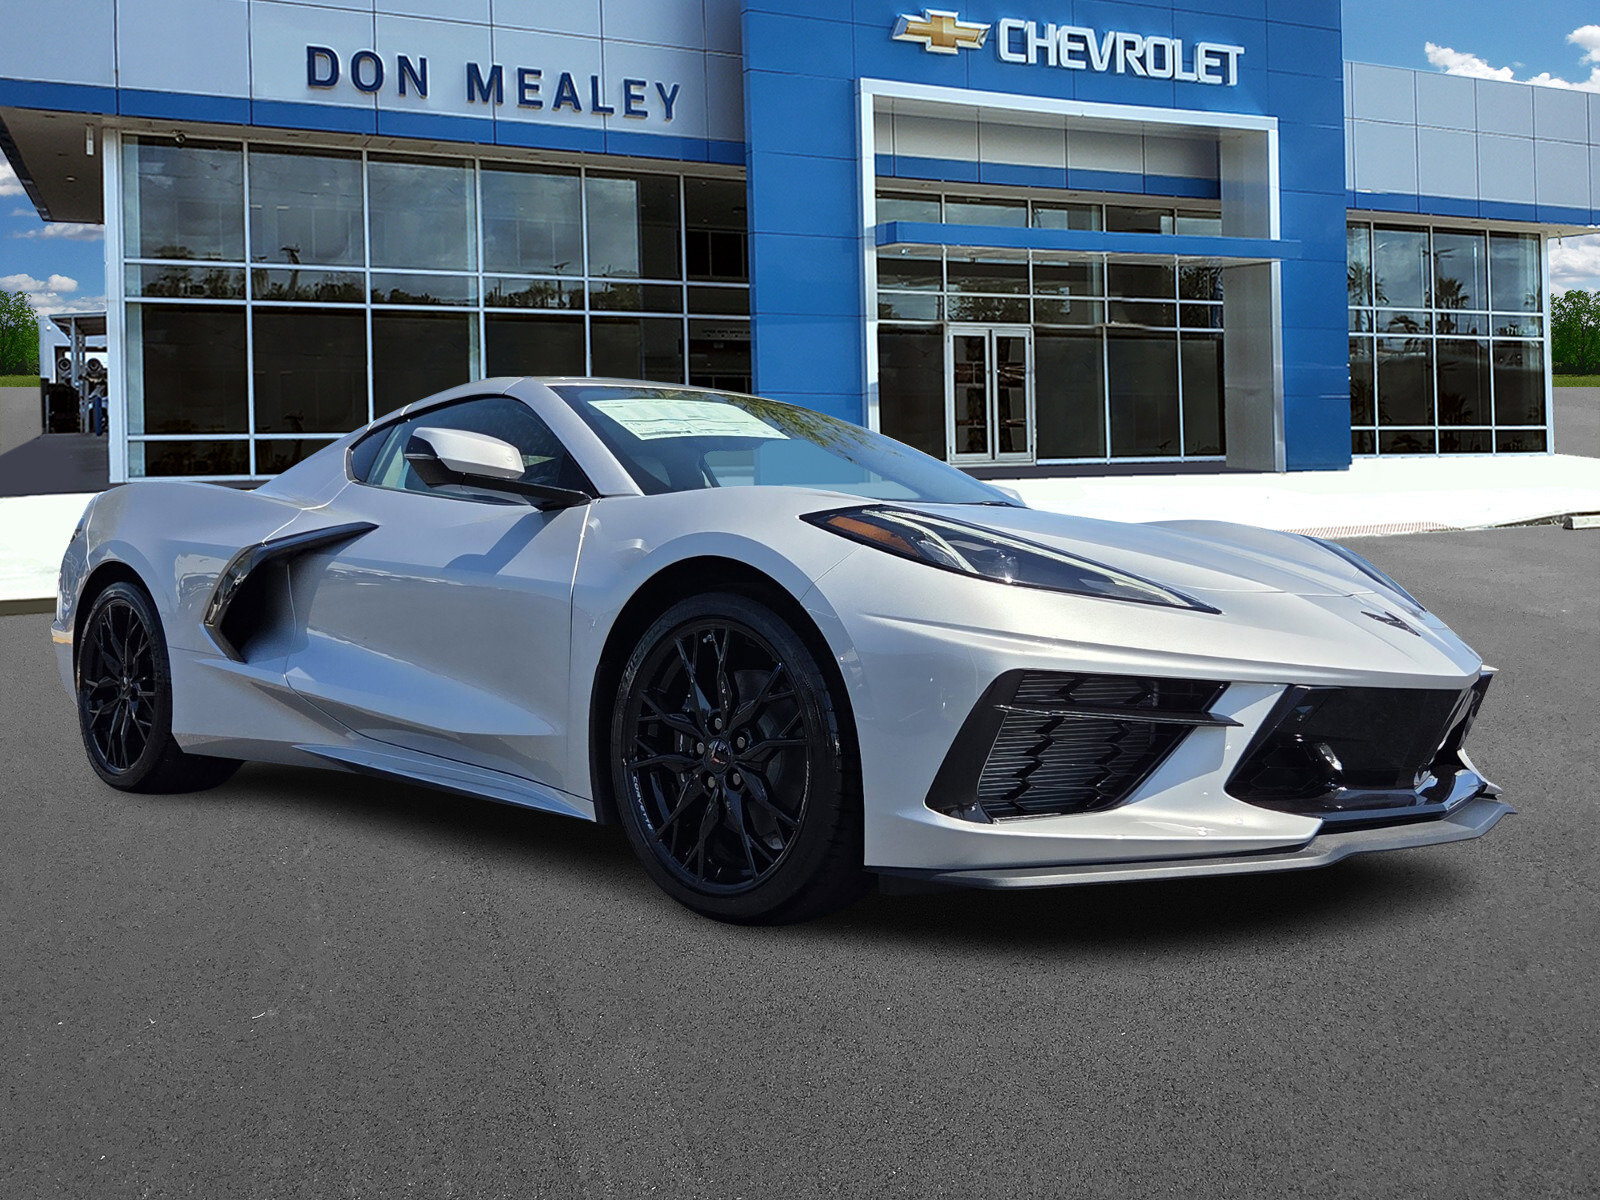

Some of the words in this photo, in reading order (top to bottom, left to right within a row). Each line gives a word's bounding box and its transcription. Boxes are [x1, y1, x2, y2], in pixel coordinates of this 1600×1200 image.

[306, 45, 429, 99] DON
[466, 61, 681, 121] MEALEY
[997, 17, 1245, 87] CHEVROLET
